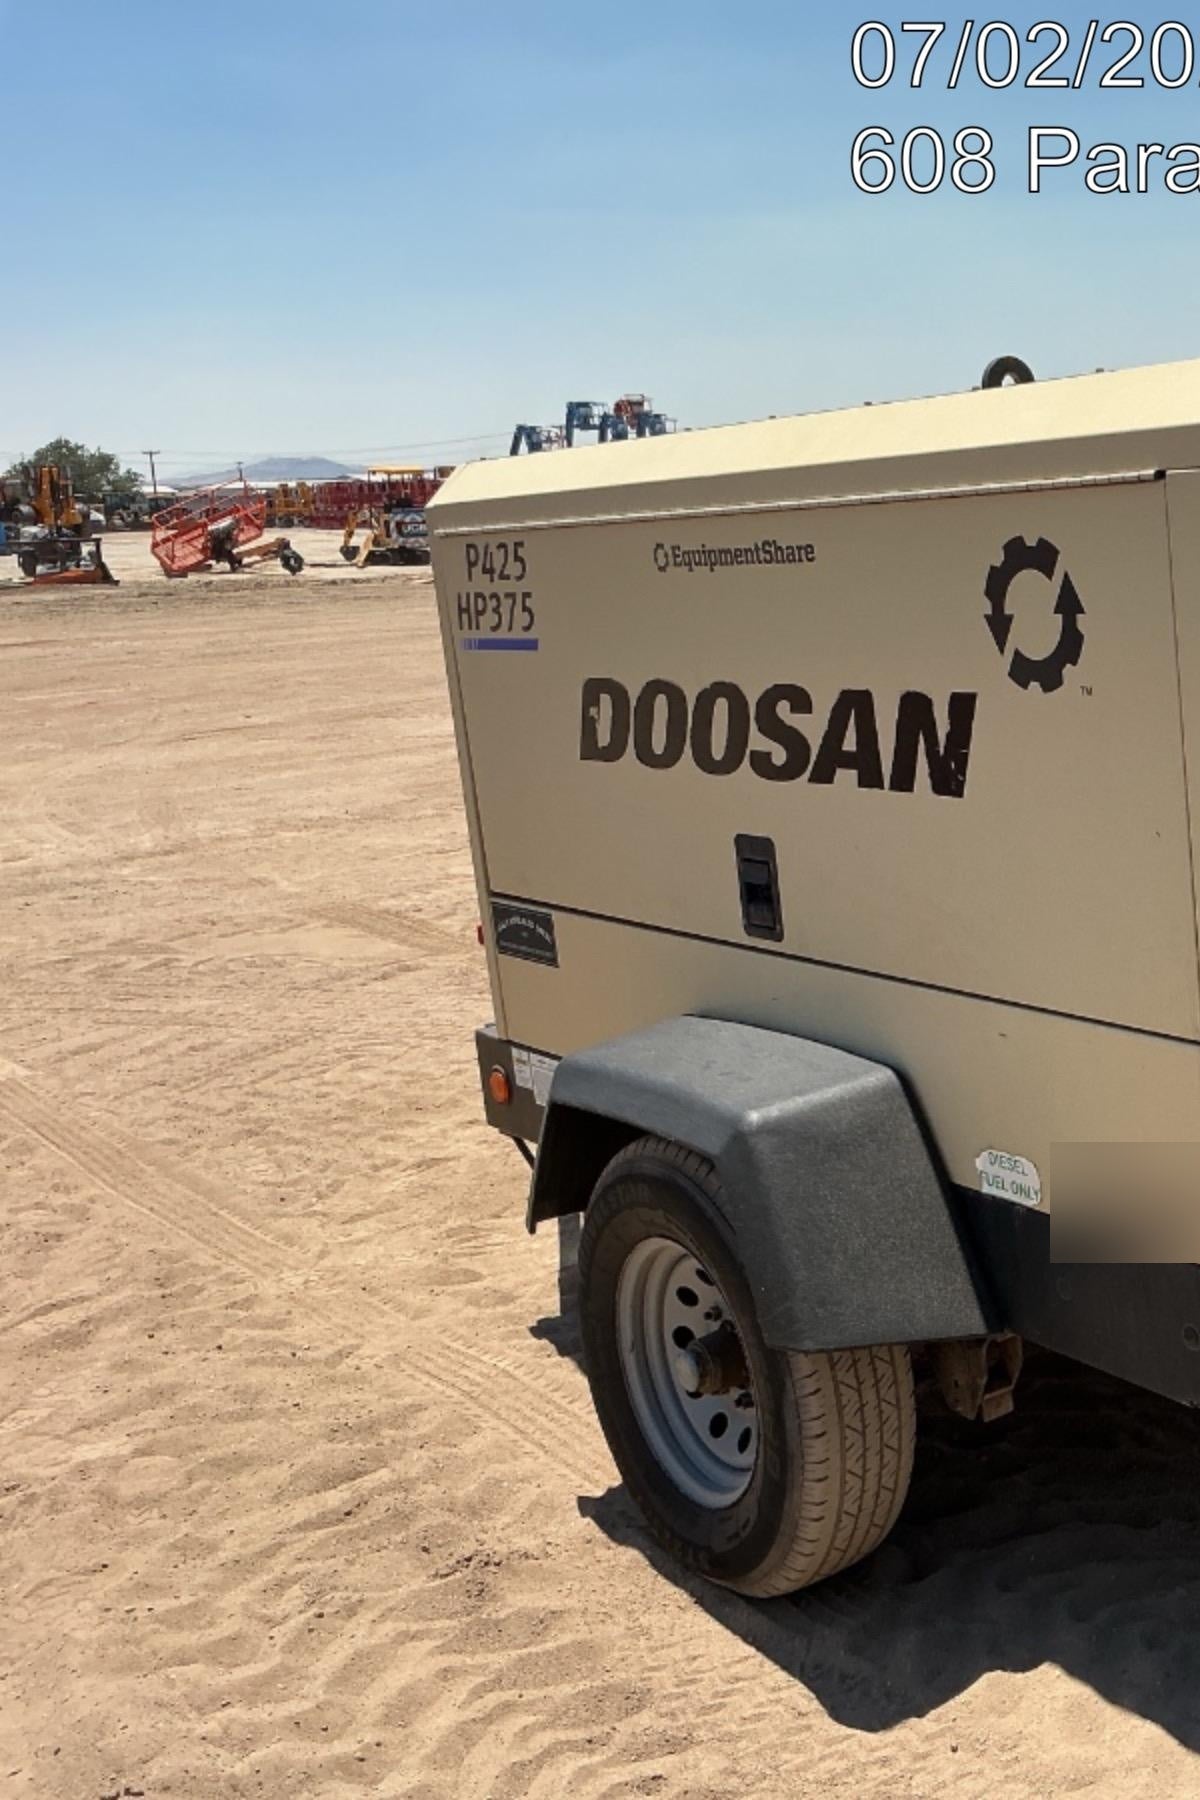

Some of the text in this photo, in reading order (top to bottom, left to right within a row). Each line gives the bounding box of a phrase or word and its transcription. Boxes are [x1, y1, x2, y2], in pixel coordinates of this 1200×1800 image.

[465, 541, 527, 583] P425
[671, 540, 815, 572] EquipmentShare
[457, 592, 535, 632] HP375
[579, 677, 978, 798] DOOSAN
[988, 1151, 1029, 1177] DIESEL
[980, 1170, 1039, 1202] FUEL ONLY
